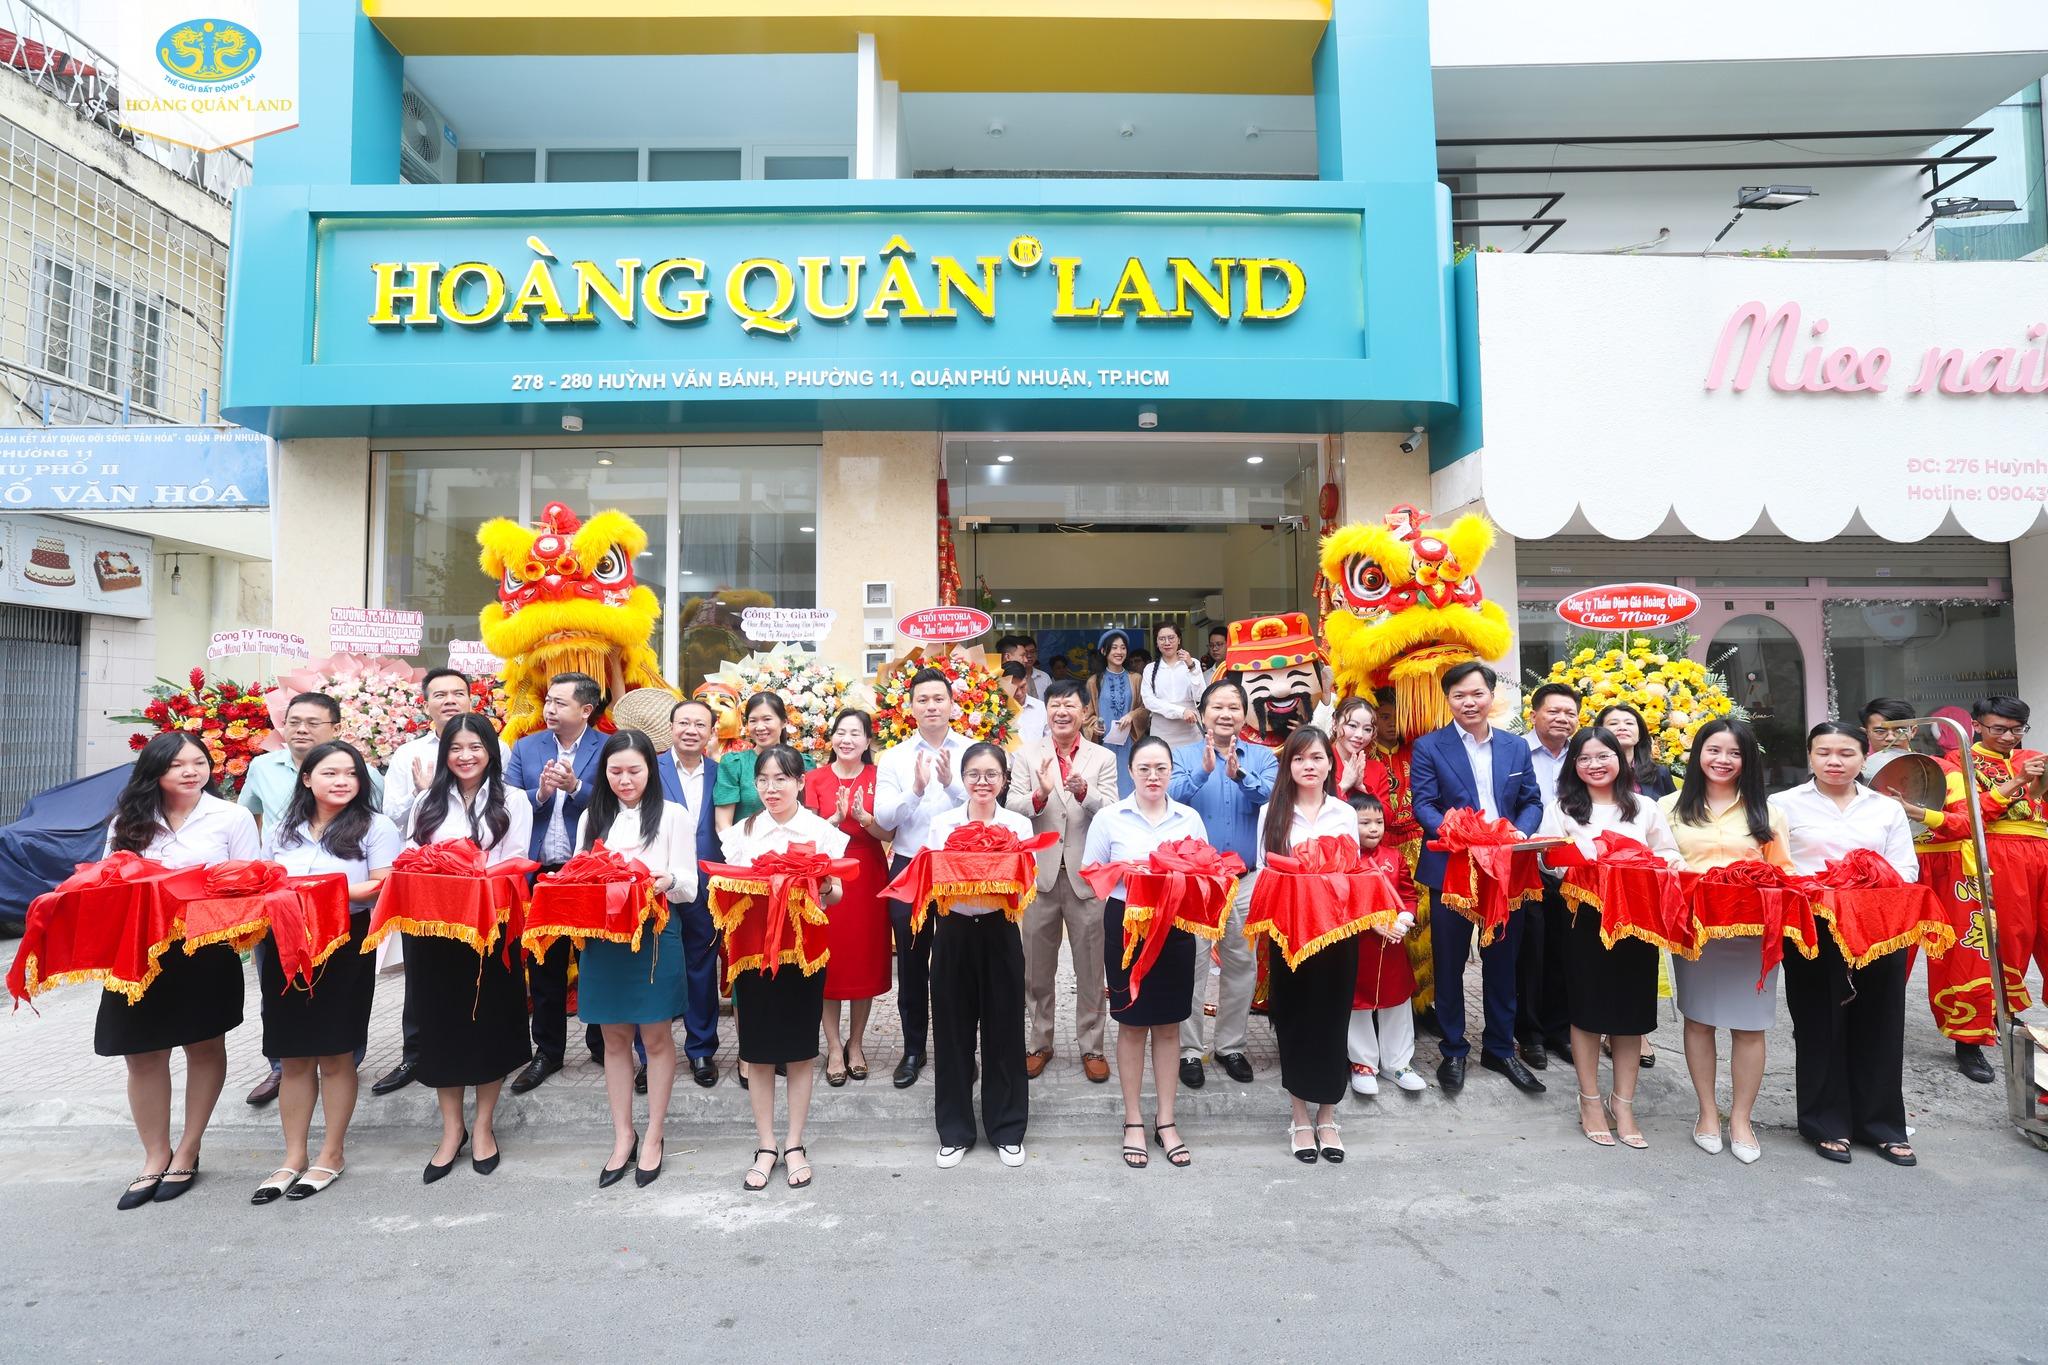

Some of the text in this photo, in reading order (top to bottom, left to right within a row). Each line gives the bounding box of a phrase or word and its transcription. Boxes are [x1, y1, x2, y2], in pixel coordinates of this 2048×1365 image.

[368, 235, 713, 328] HOÀNG
[1050, 256, 1308, 326] LAND
[1703, 301, 2048, 394] Miee nai
[511, 373, 544, 391] 278
[561, 372, 593, 391] 280
[599, 366, 666, 390] HUỲNH
[672, 366, 713, 389] VĂN
[718, 365, 779, 390] BÁNH,
[785, 366, 874, 388] PHƯỜNG
[880, 371, 905, 390] 11,
[911, 365, 967, 391] QUẬN
[971, 364, 1012, 387] PHÚ
[1017, 364, 1093, 391] NHUẬN,
[1098, 370, 1170, 387] TP.HCM
[0, 448, 69, 458] HƯỜNG
[34, 457, 88, 475] PHỐ
[1906, 458, 2048, 477] ĐC: 276 Huỳnh
[50, 480, 139, 504] VĂN
[154, 478, 248, 504] HÓA
[1907, 484, 2048, 502] Hotline: 09043
[938, 612, 972, 622] VICTORIA
[1581, 610, 1670, 625] Chúc Mừng
